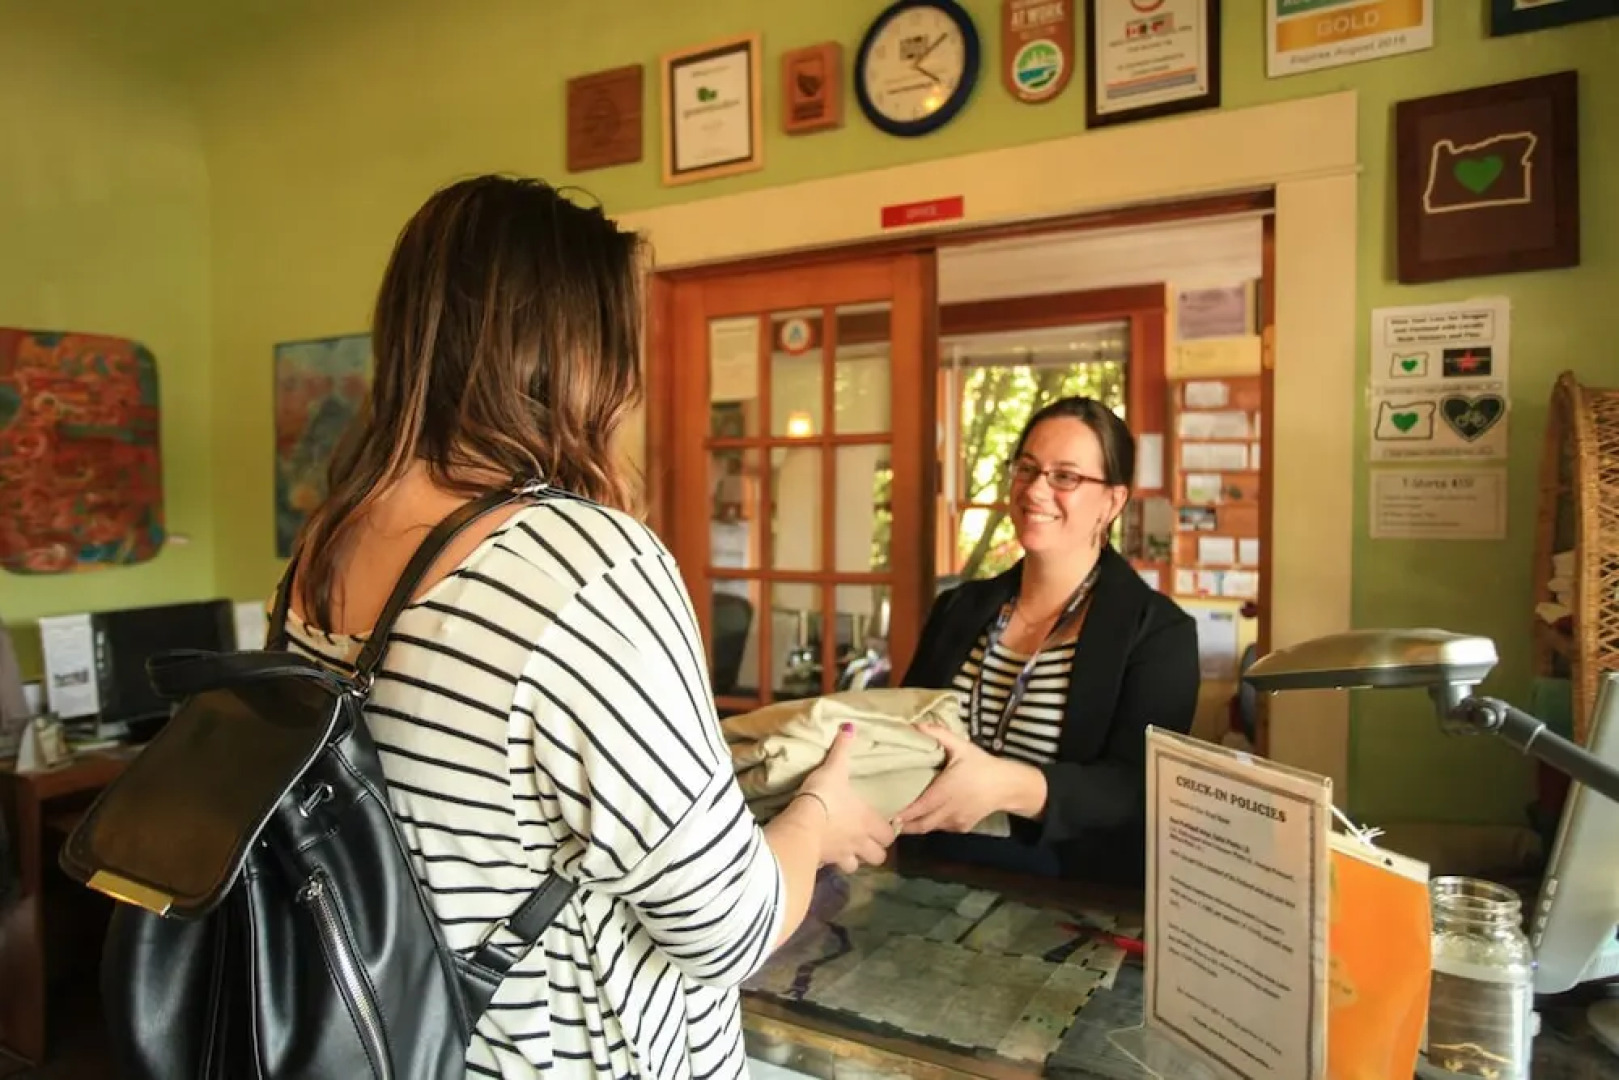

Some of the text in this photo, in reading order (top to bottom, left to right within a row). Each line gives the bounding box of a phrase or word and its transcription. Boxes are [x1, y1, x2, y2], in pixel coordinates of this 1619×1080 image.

[1316, 9, 1379, 36] GOLD
[1333, 43, 1375, 58] August
[1176, 775, 1228, 802] CHECK-IN
[1230, 793, 1288, 823] POLICIES
